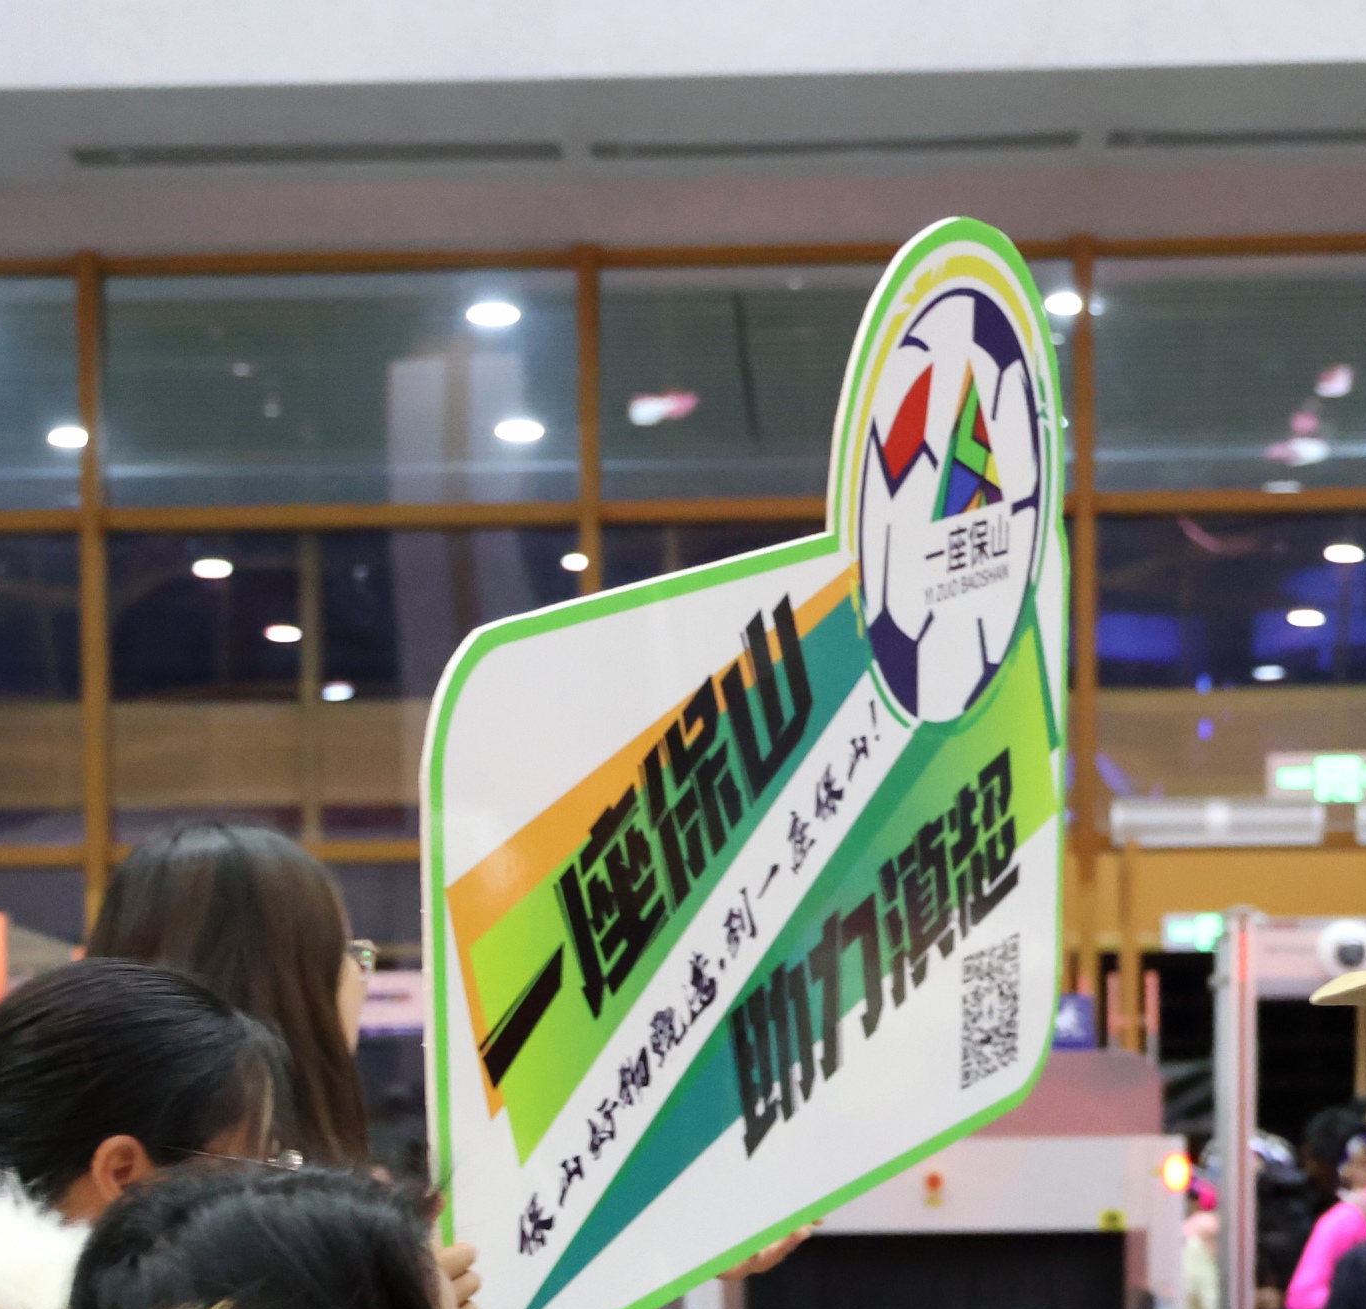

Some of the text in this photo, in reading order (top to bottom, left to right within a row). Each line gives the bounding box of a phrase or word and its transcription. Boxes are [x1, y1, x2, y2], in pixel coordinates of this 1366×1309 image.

[924, 513, 1011, 573] 一座保山
[960, 563, 1009, 595] BAOSHAN
[479, 593, 813, 1089] 一座保山
[732, 747, 1021, 1160] 助力滇超
